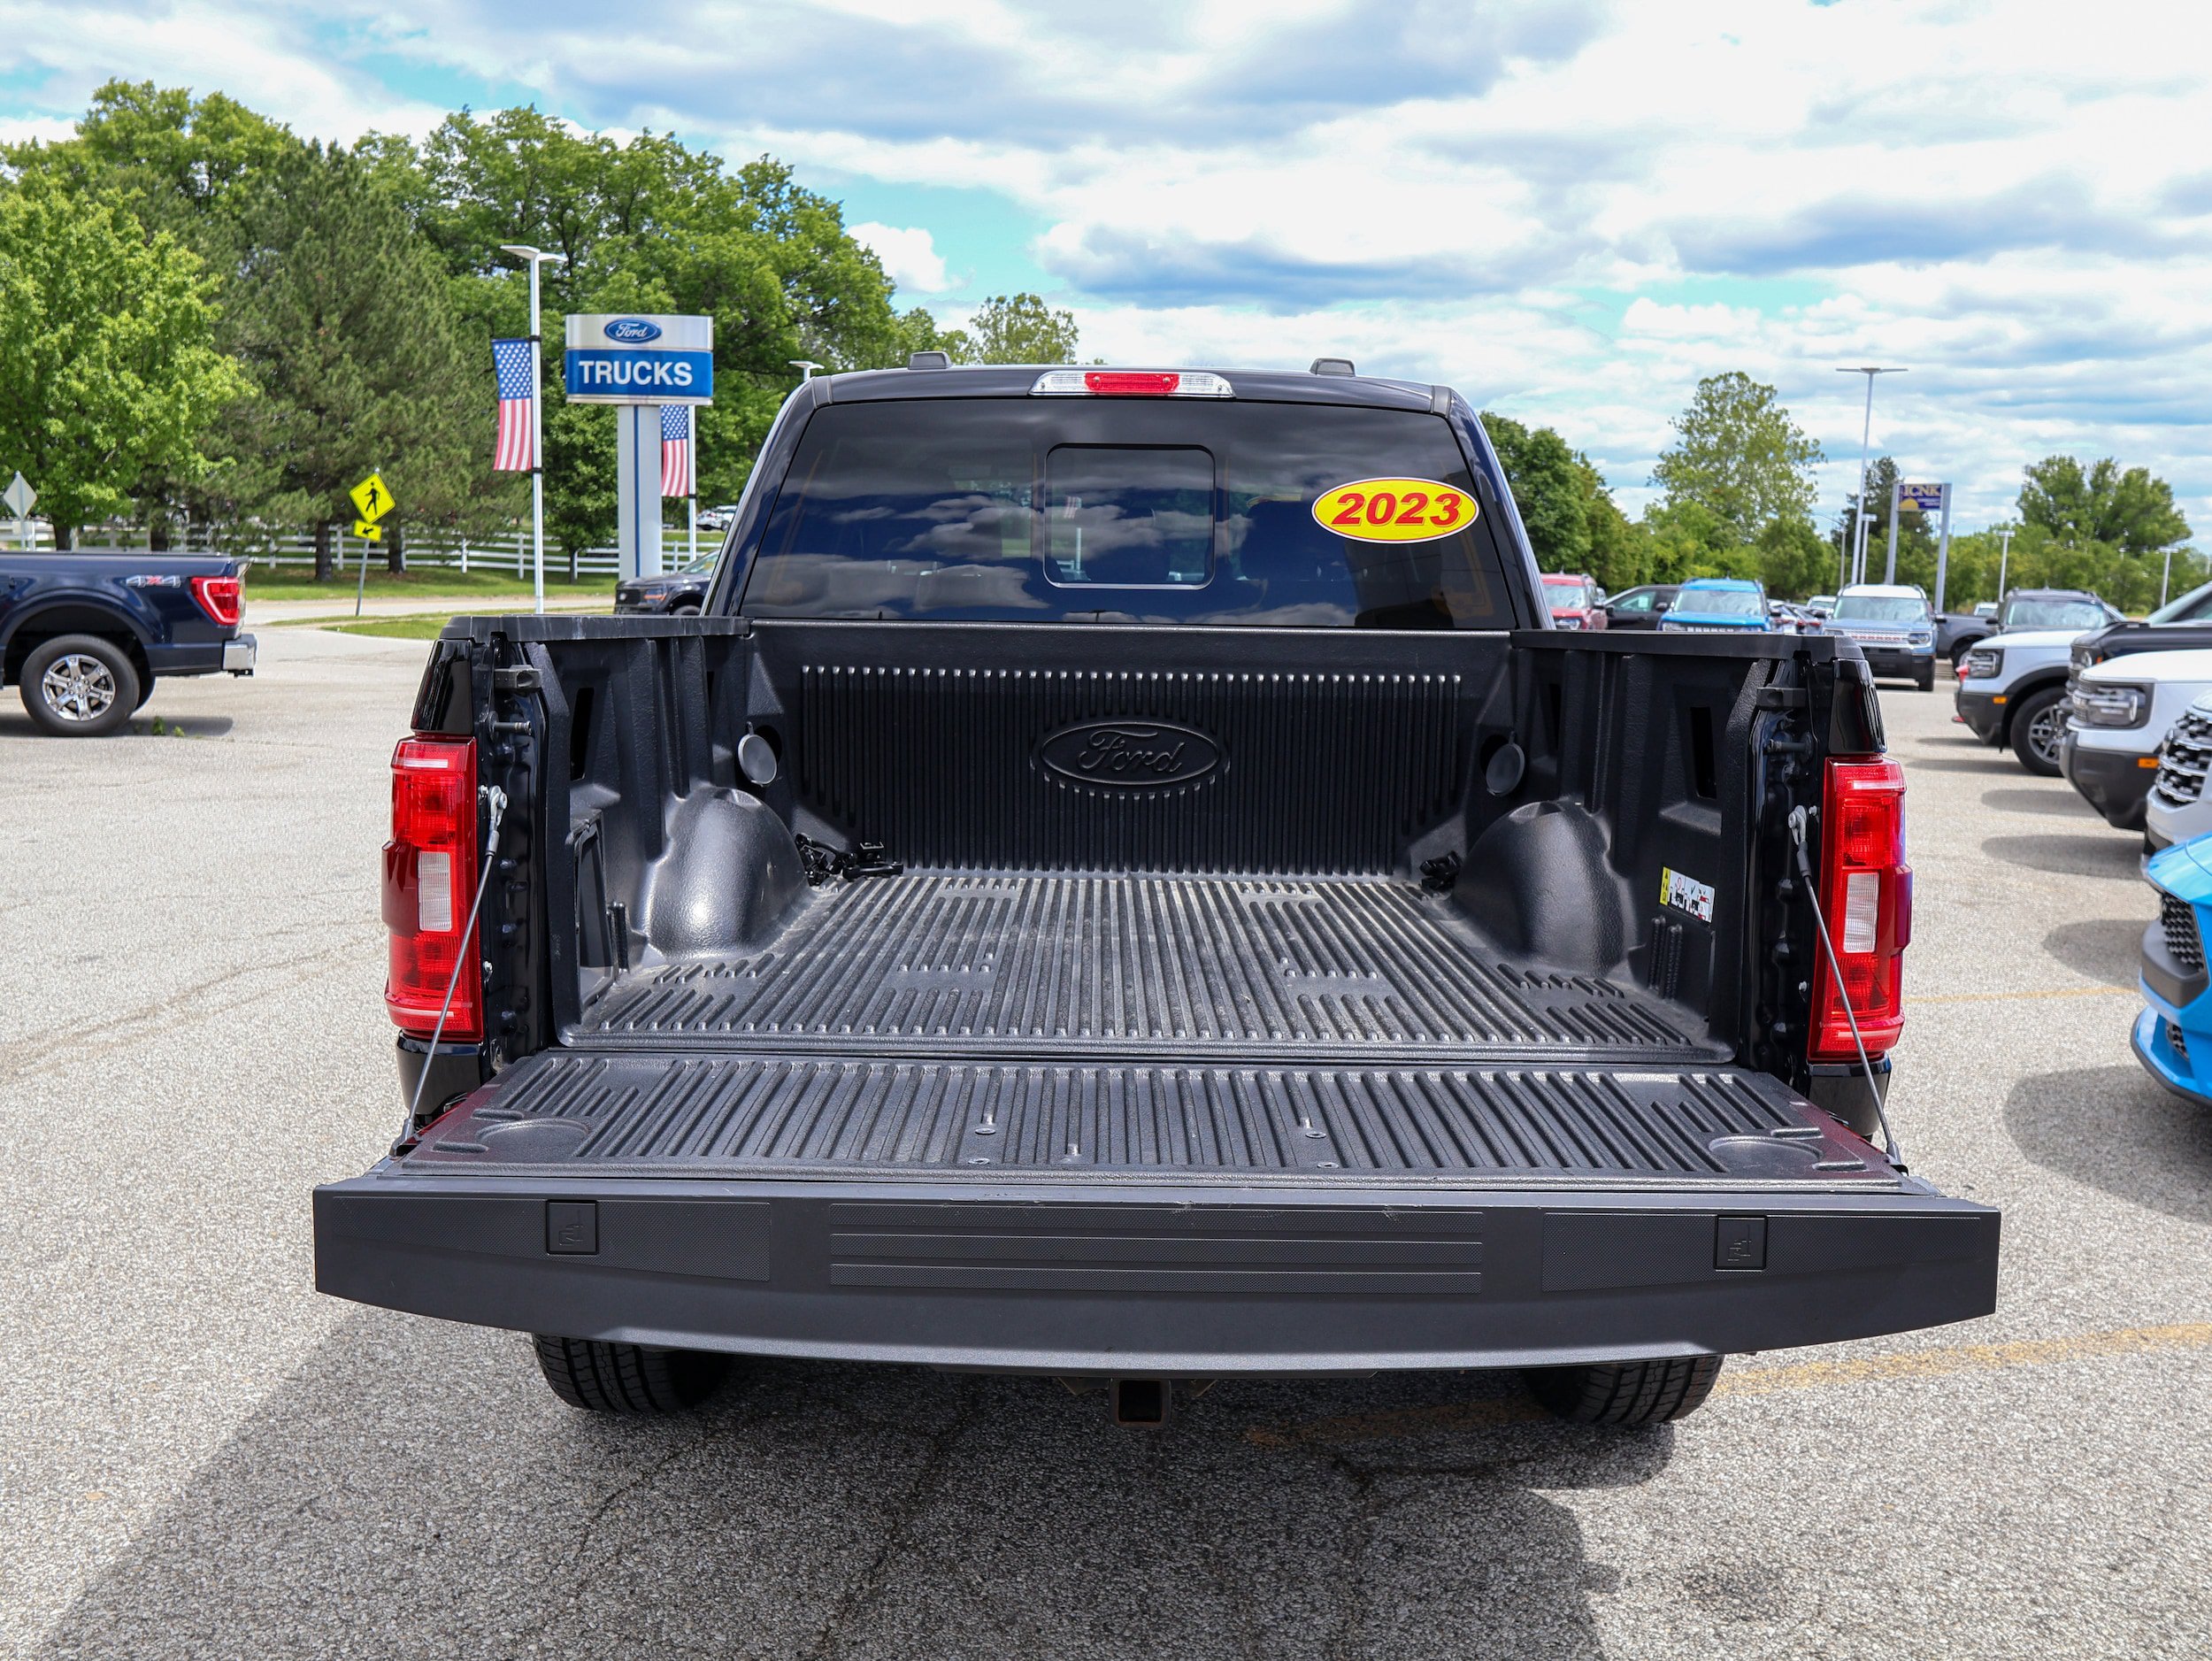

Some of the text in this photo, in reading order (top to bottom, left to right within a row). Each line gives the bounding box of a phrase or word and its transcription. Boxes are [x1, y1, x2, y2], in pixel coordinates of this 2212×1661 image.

[615, 323, 648, 338] Ford
[579, 360, 693, 386] TRUCKS
[1332, 492, 1460, 526] 2023
[1078, 730, 1185, 773] Ford
